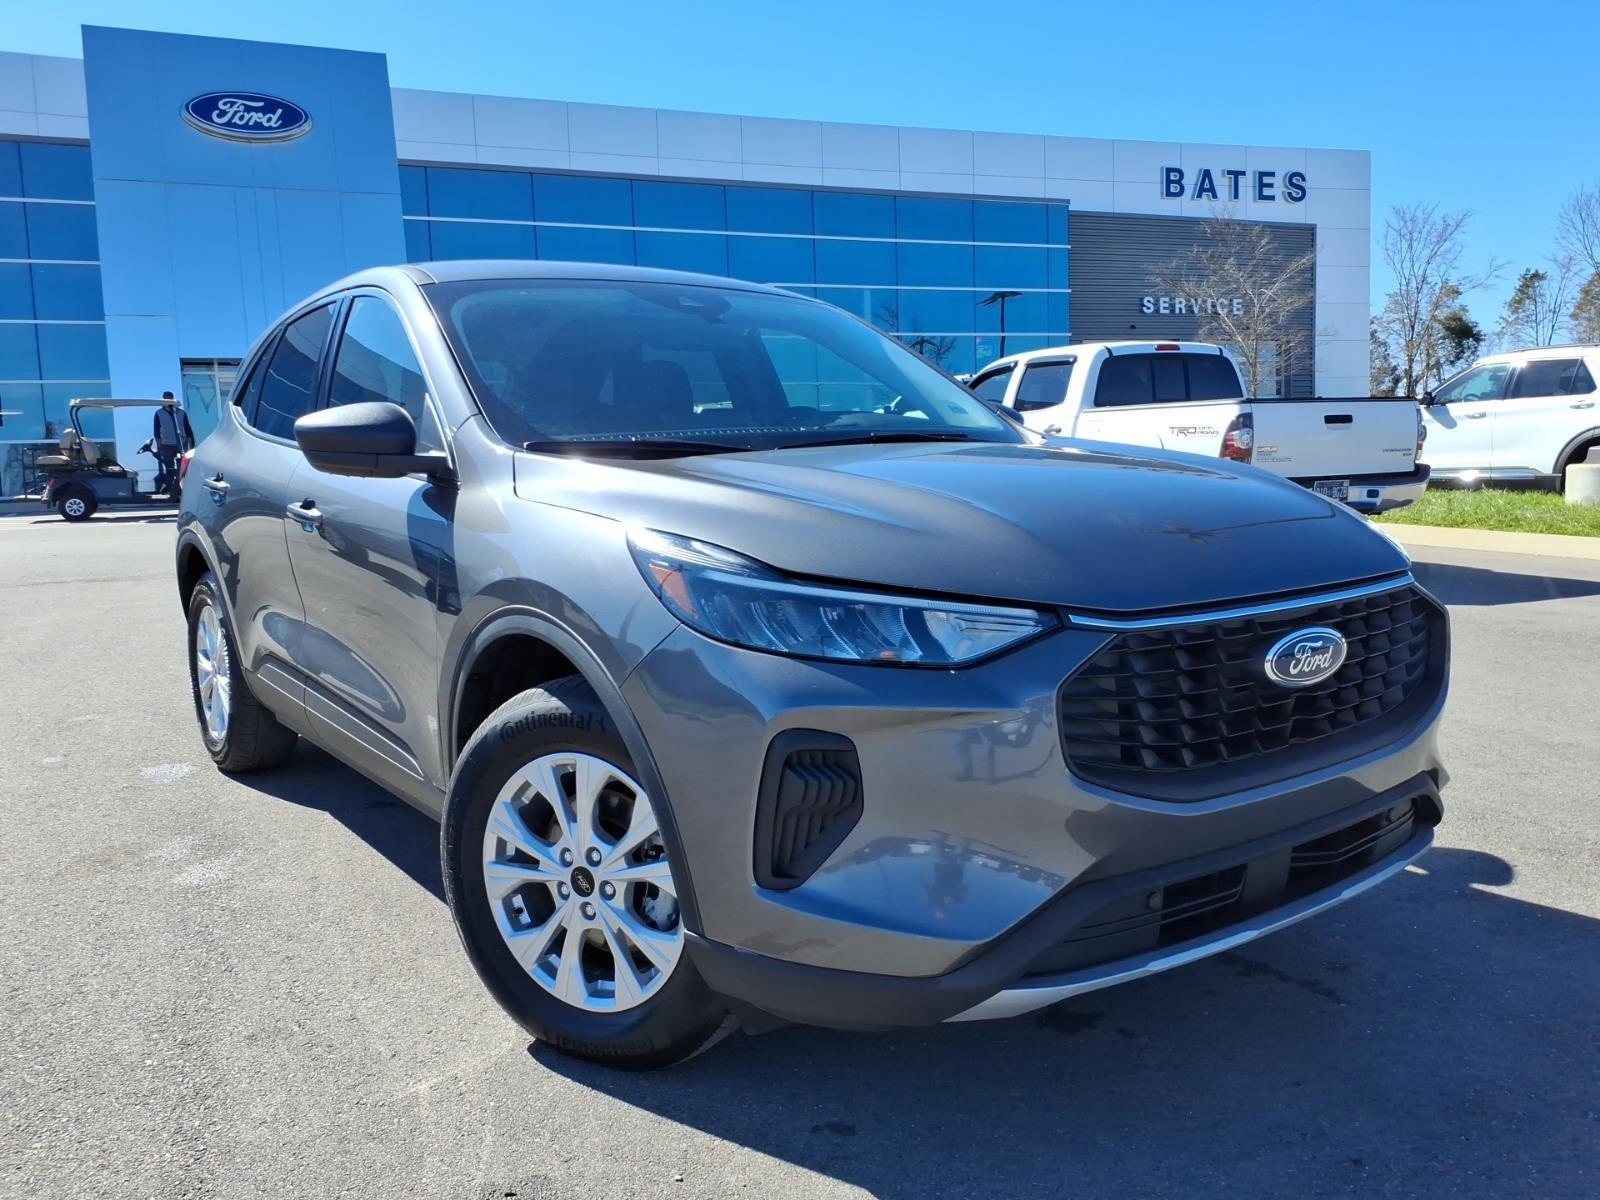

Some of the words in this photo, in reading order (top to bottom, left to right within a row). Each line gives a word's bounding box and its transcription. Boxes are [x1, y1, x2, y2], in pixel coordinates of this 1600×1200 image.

[211, 98, 283, 128] Ford
[1162, 166, 1307, 203] BATES
[1142, 296, 1245, 315] SERVICE
[1289, 640, 1334, 675] Ford
[500, 709, 593, 743] Continental
